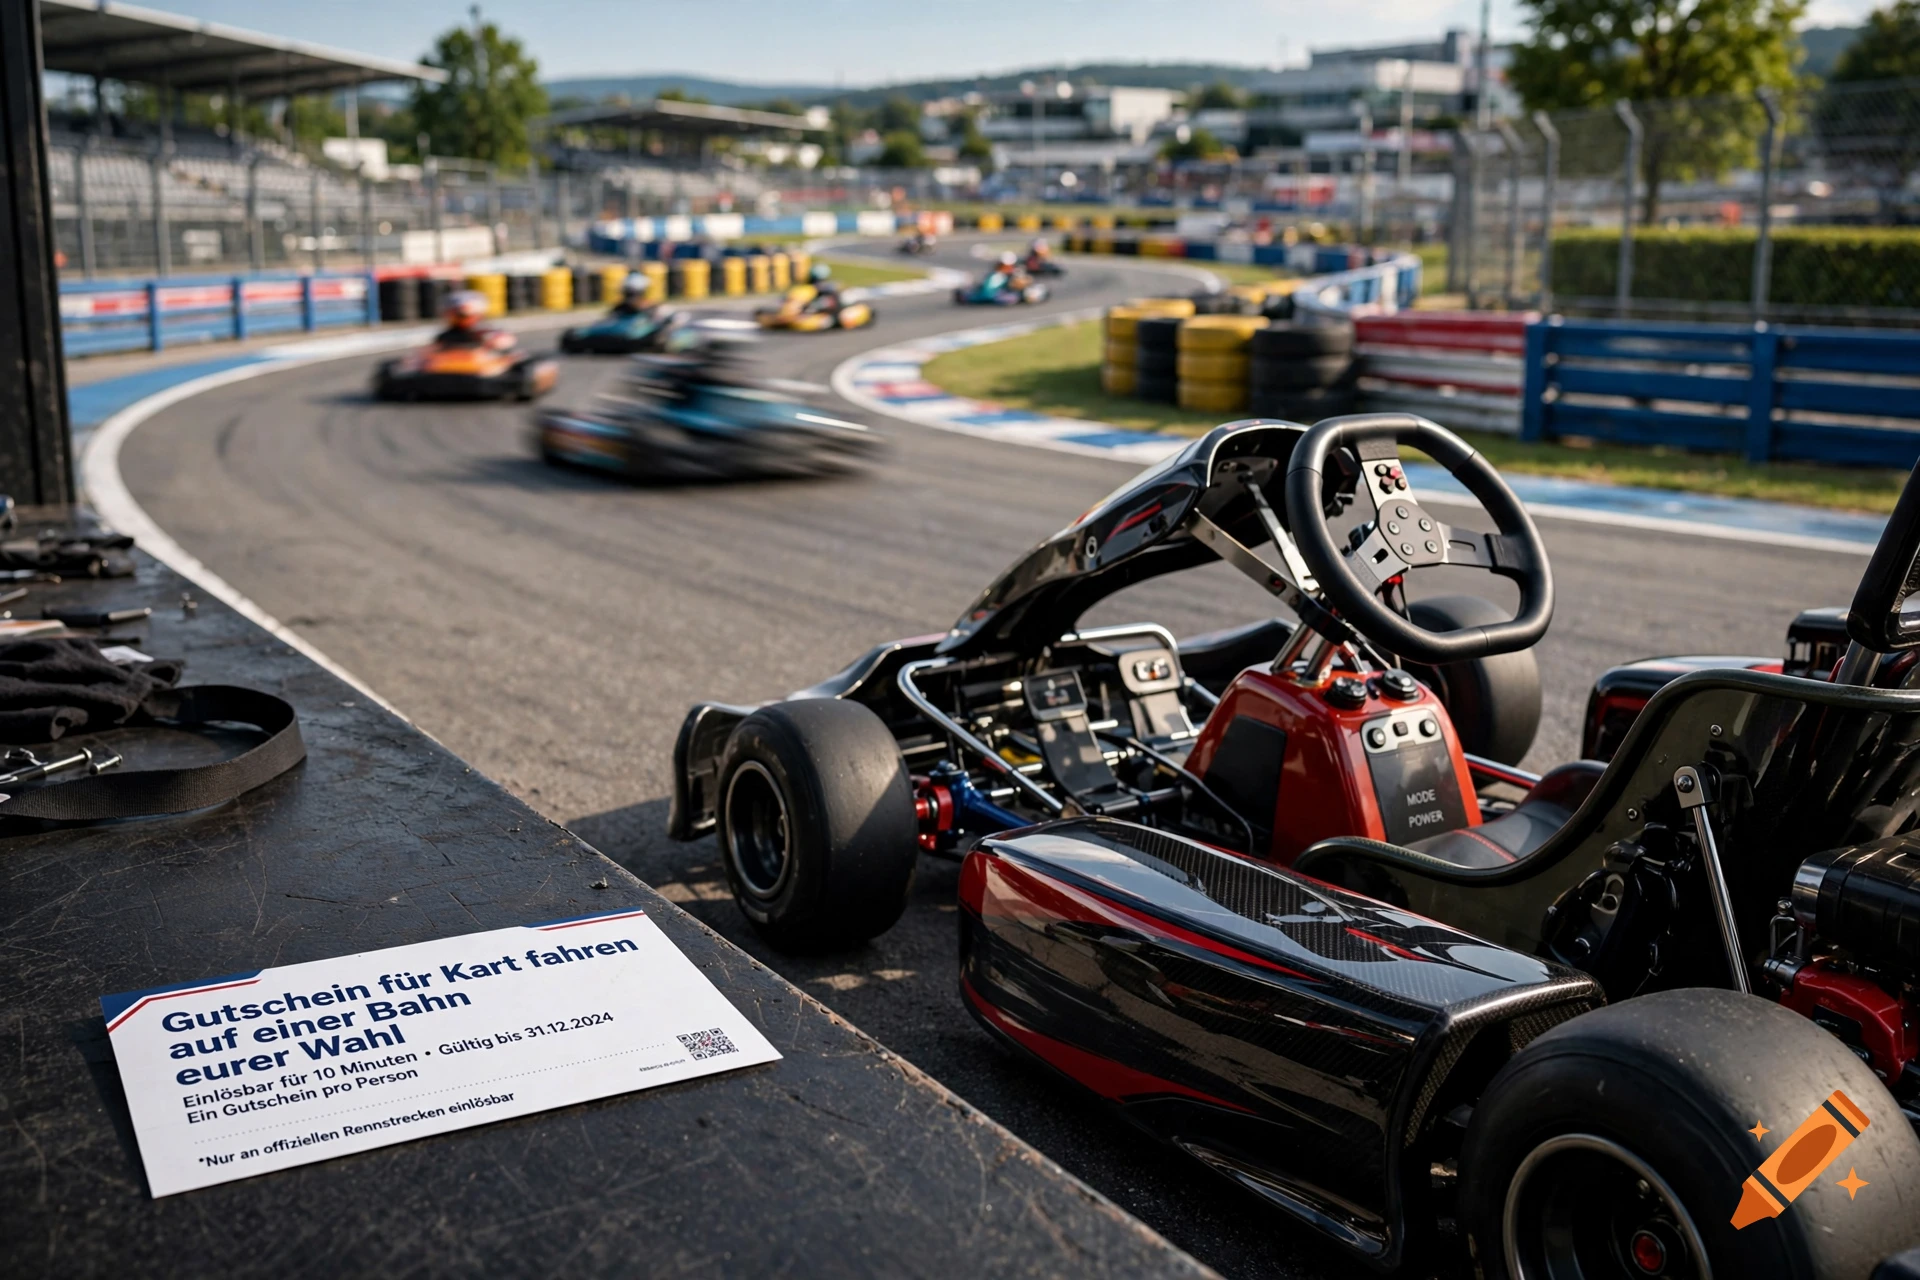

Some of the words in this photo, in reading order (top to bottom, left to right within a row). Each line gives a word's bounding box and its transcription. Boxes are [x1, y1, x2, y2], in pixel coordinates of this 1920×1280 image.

[1407, 789, 1436, 806] MODE
[1408, 809, 1444, 828] POWER
[162, 984, 371, 1032] Gutschein
[377, 971, 432, 995] für
[439, 955, 523, 984] Kart
[524, 939, 639, 968] fahren
[169, 1026, 239, 1060] auf
[252, 1011, 356, 1043] einer
[365, 992, 472, 1023] Bahn
[176, 1049, 290, 1086] eurer
[298, 1024, 406, 1061] Wahl
[183, 1081, 275, 1109] Einlösbar
[279, 1073, 308, 1089] für
[312, 1067, 336, 1081] 10
[340, 1053, 418, 1076] Minuten
[438, 1037, 494, 1055] Gültig
[494, 1031, 523, 1045] bis
[524, 1011, 614, 1038] 31.12.2024
[186, 1109, 218, 1124] Ein
[222, 1088, 318, 1116] Gutschein
[321, 1082, 353, 1099] pro
[356, 1067, 418, 1089] Person
[240, 1148, 260, 1160] an
[263, 1131, 340, 1154] offiziellen
[342, 1108, 446, 1137] Rennstrecken
[448, 1092, 514, 1114] einlösbar
